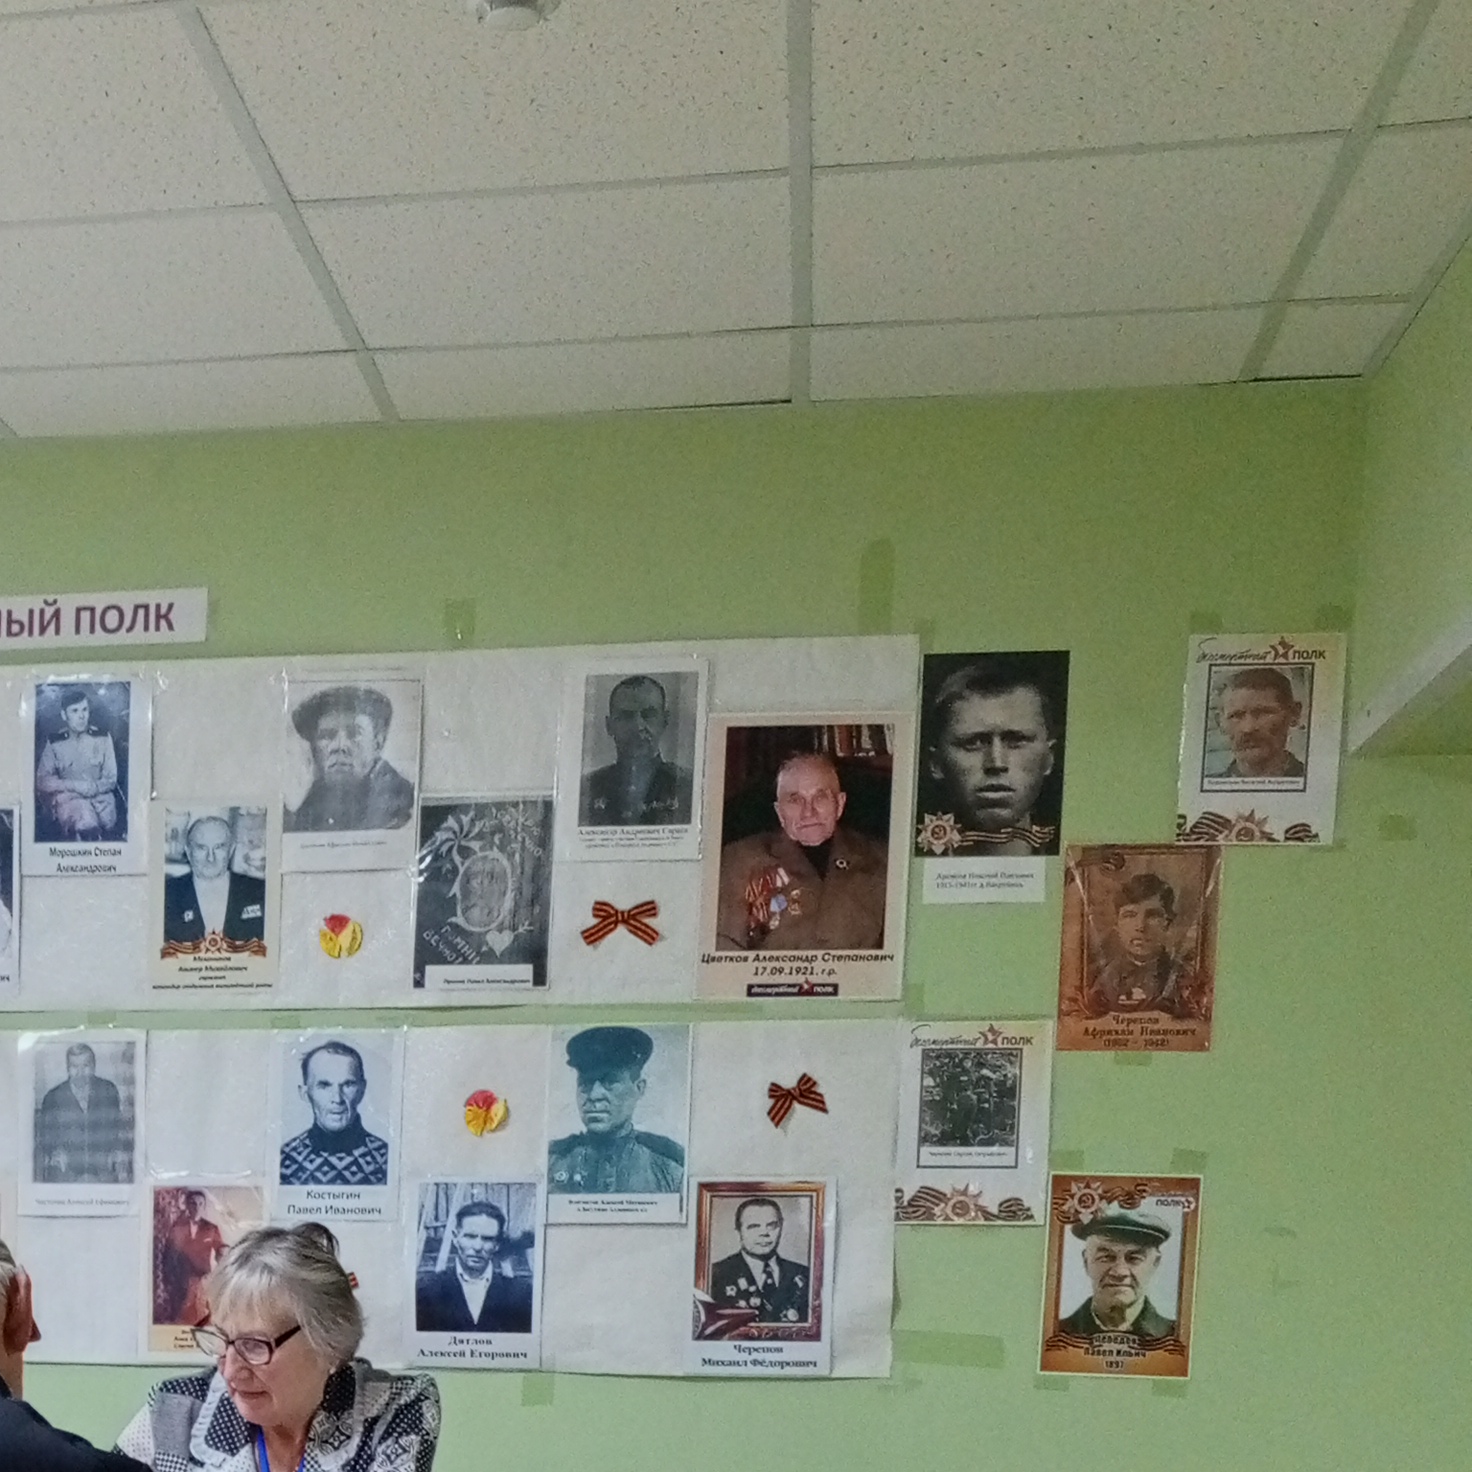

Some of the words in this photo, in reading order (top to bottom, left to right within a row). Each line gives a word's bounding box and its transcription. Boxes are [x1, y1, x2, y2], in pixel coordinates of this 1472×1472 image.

[74, 602, 175, 635] ПОЛК
[49, 847, 92, 858] Морошкин
[94, 847, 122, 857] Степан
[56, 863, 117, 874] Александрович
[701, 954, 748, 964] Цветков
[752, 953, 817, 965] Александр
[821, 952, 894, 962] Степанович
[306, 1190, 361, 1200] Костыгин
[287, 1204, 322, 1215] Павел
[325, 1205, 382, 1215] Иванович
[448, 1336, 493, 1347] Дятлов
[417, 1348, 466, 1359] Алексей
[470, 1348, 528, 1361] Егорович
[733, 1344, 784, 1356] Черепов
[701, 1357, 748, 1367] Михаил
[750, 1357, 818, 1370] Фёдорович
